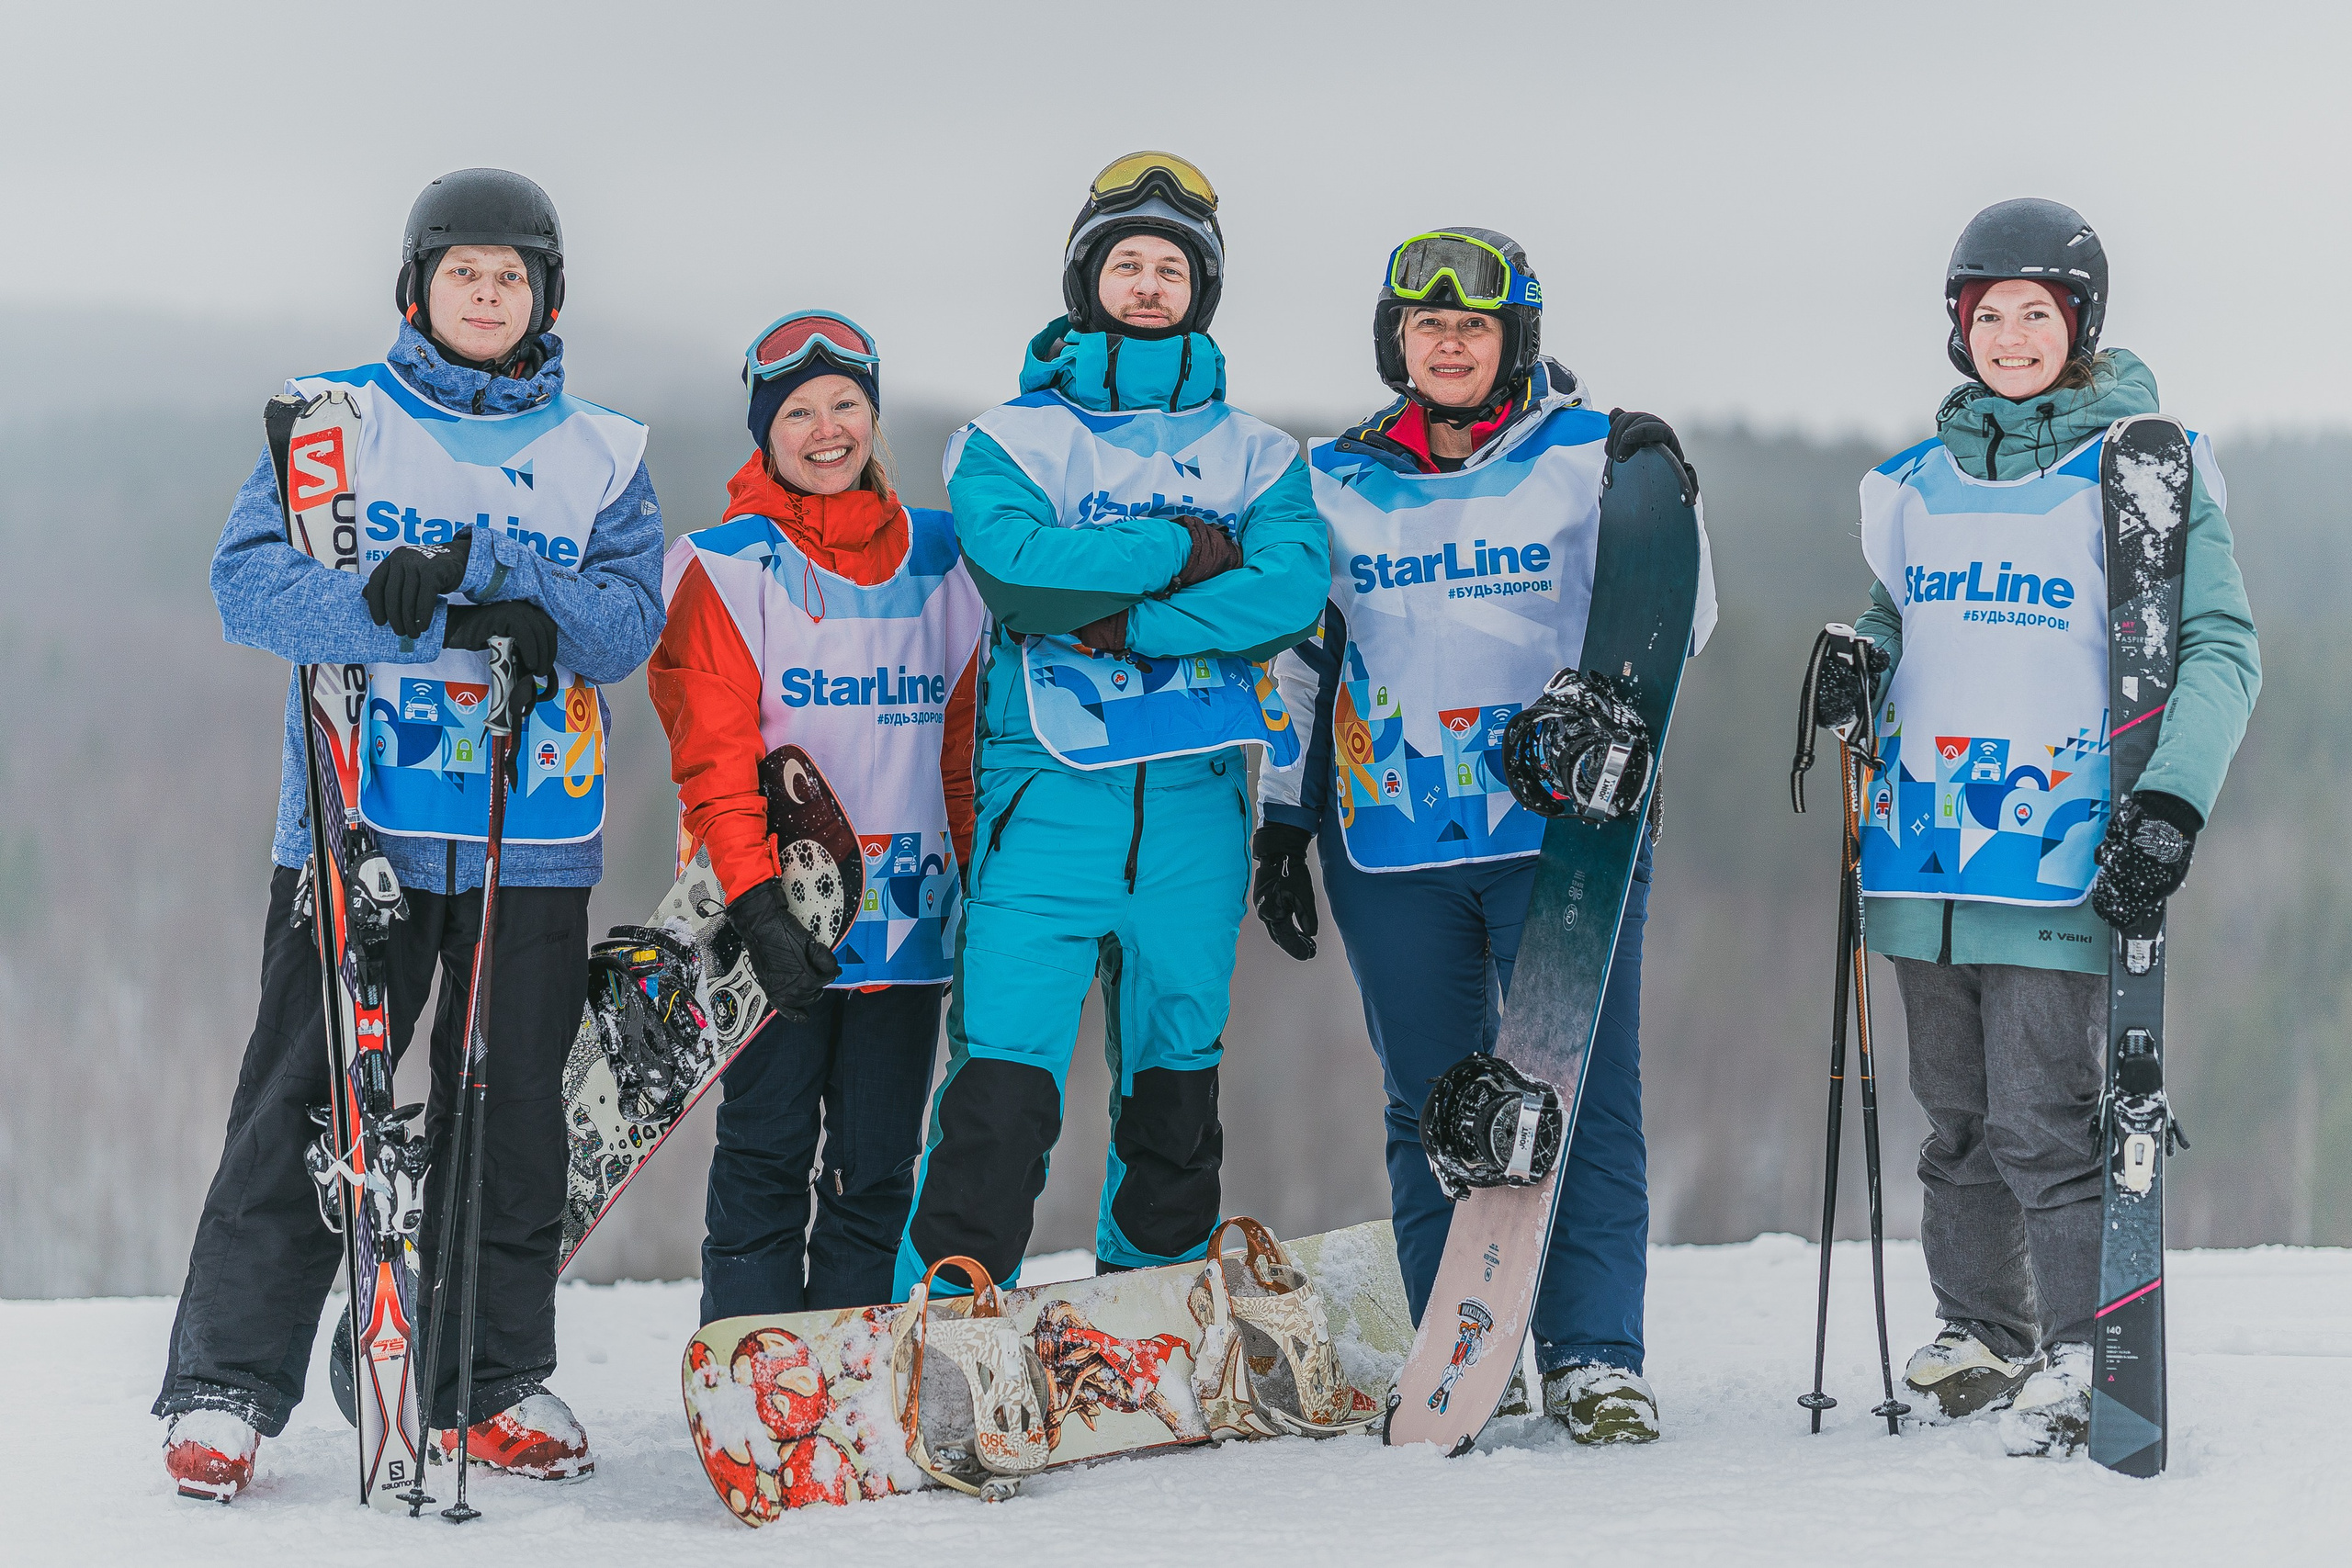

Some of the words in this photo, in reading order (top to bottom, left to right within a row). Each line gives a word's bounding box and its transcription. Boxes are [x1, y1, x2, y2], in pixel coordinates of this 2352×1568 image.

[1349, 539, 1552, 593] StarLine
[1448, 580, 1553, 599] #БУДЬЗДОРОВ!
[1905, 561, 2075, 609] StarLine
[1962, 610, 2070, 632] #БУДЬЗДОРОВ!
[2121, 636, 2145, 644] ASPIR
[781, 665, 945, 708] StarLine
[1599, 779, 1611, 801] JOINT
[2106, 1325, 2122, 1336] 140
[381, 1479, 415, 1491] salomon
